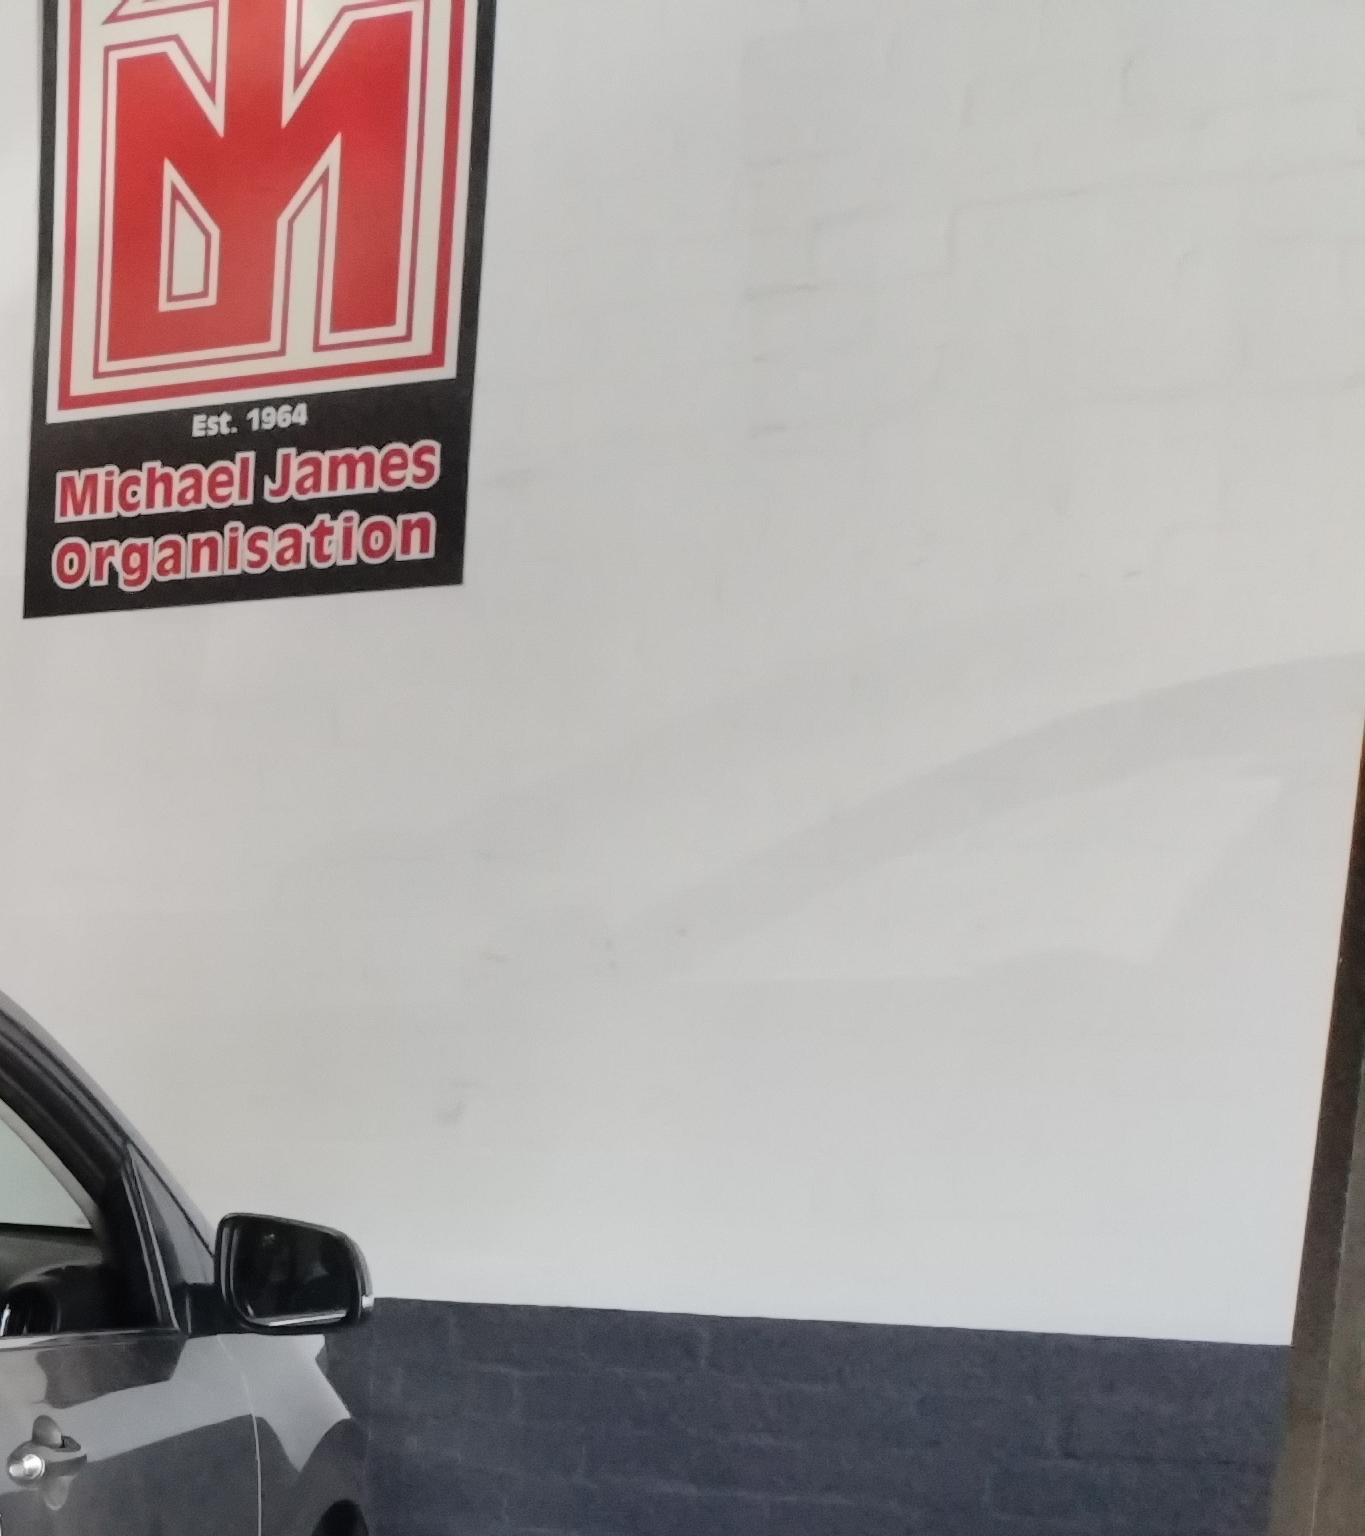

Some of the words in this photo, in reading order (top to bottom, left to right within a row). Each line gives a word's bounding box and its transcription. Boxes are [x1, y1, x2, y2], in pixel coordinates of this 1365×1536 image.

[191, 411, 239, 438] Est.
[246, 402, 309, 434] 1964
[55, 451, 256, 523] Michael
[264, 439, 441, 502] James
[52, 510, 436, 592] Organisation
